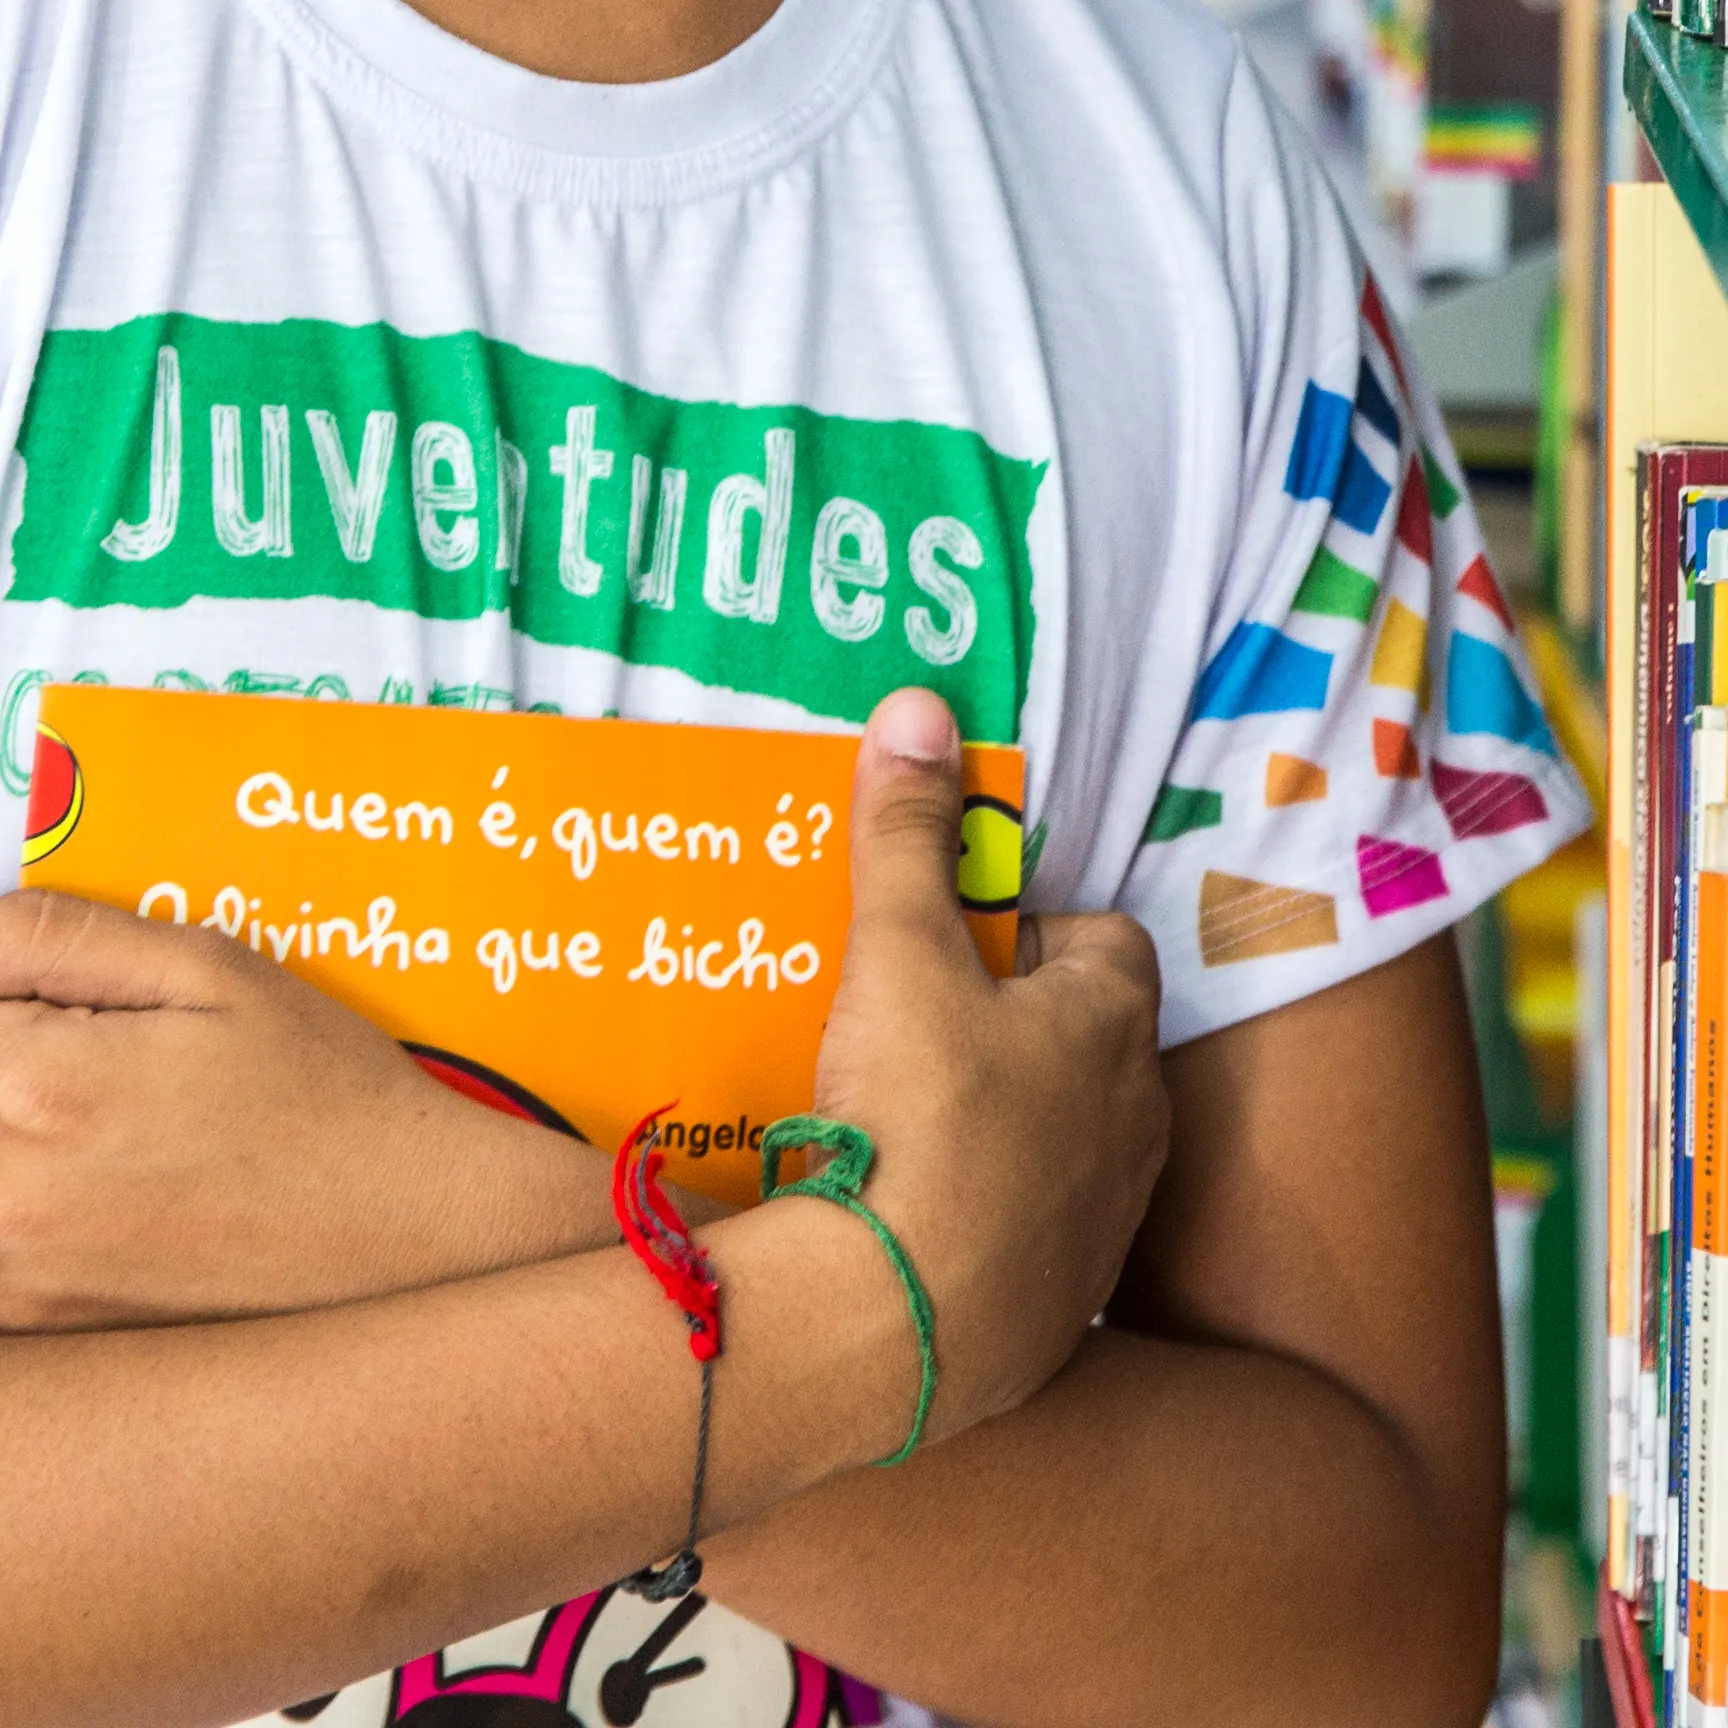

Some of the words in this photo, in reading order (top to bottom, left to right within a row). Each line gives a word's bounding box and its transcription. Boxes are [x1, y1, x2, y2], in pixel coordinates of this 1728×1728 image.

[100, 345, 983, 667] Juventudes
[236, 770, 453, 847] Quem
[478, 768, 537, 857] é,
[550, 806, 742, 880] quem
[764, 794, 833, 870] é?
[476, 923, 601, 994] que
[628, 913, 821, 992] bicho
[1703, 1018, 1717, 1177] Humanos
[1701, 1191, 1712, 1322] Direitos
[1701, 1337, 1709, 1388] em
[1695, 1399, 1707, 1618] Conselheiros
